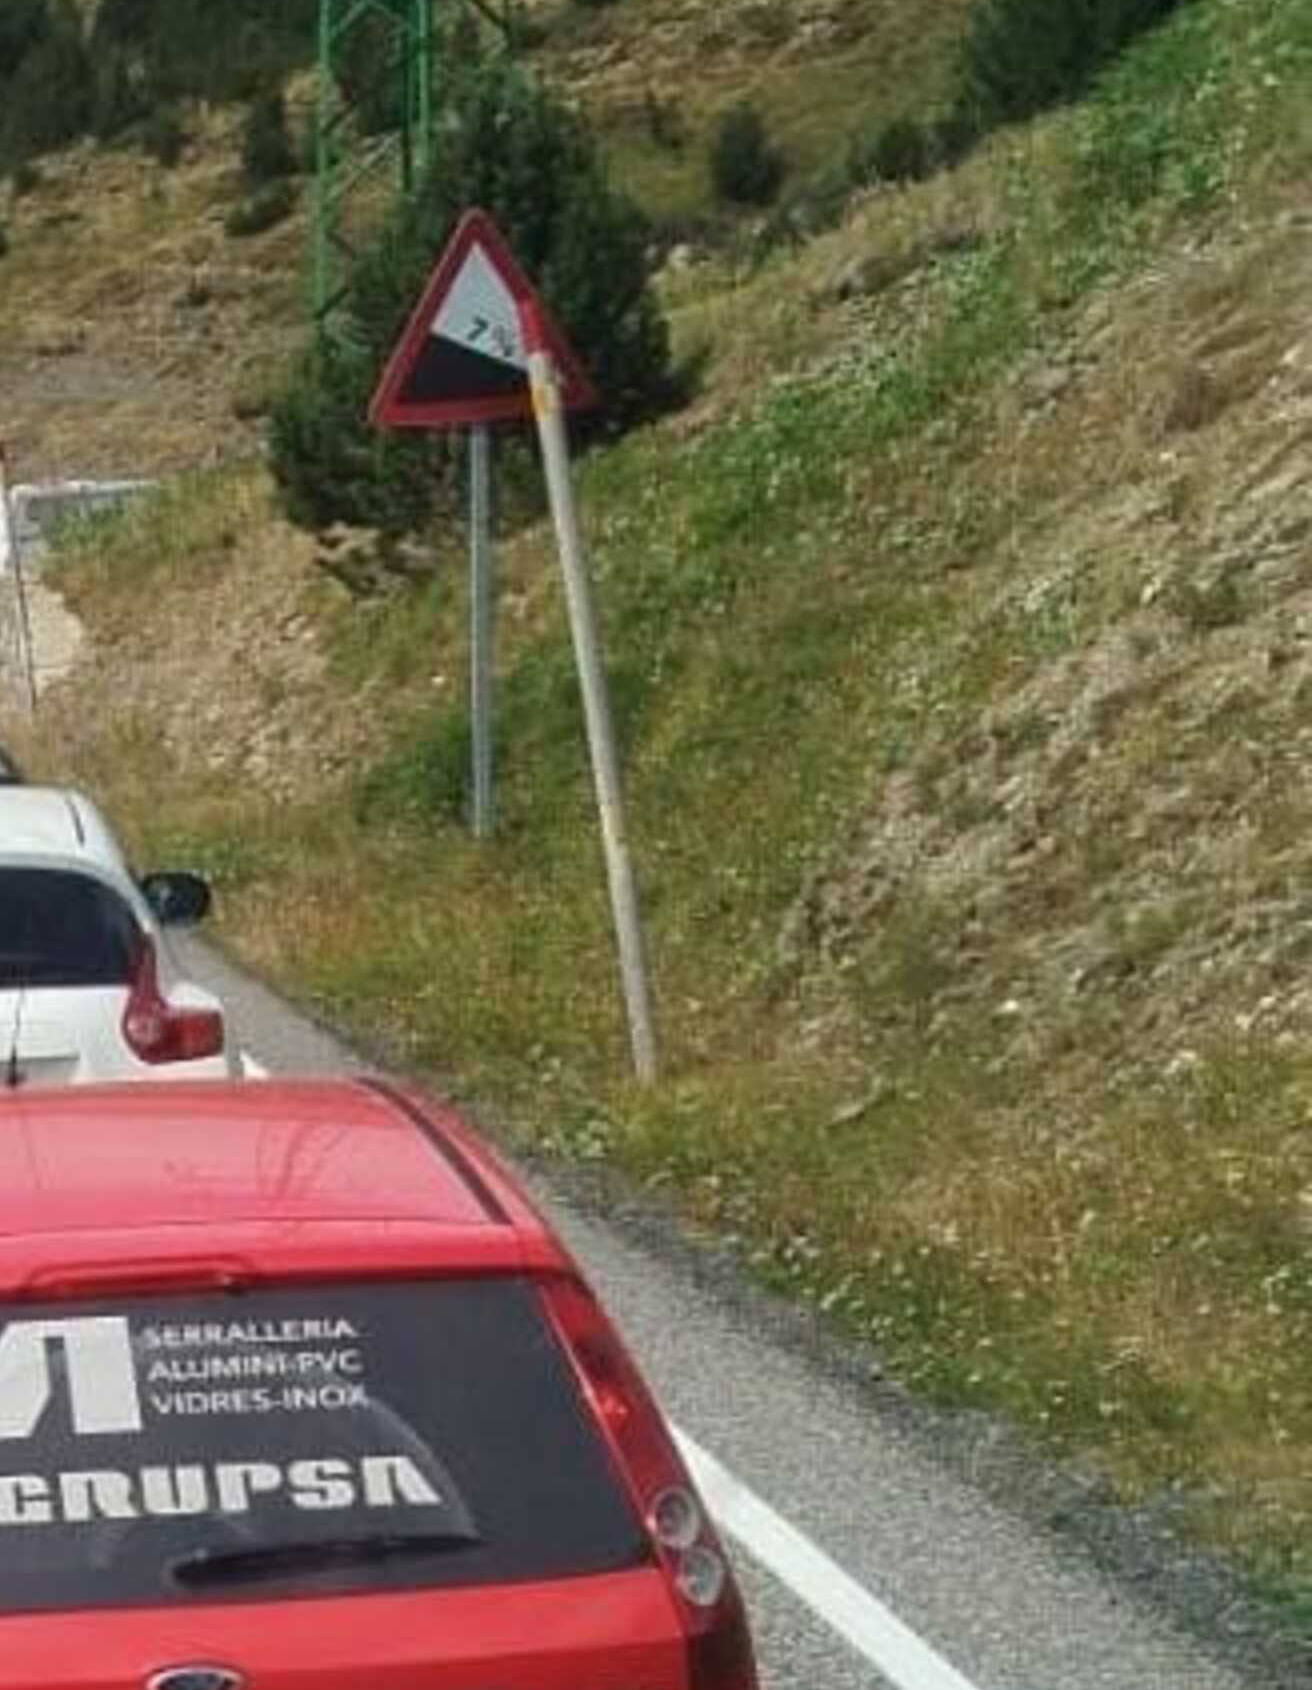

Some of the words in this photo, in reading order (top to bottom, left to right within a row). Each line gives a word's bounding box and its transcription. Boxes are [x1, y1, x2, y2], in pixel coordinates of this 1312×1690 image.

[144, 1318, 359, 1350] SERRALLERIA
[147, 1348, 365, 1382] ALUMINI-PVC
[152, 1384, 370, 1416] VIDRES-INOX
